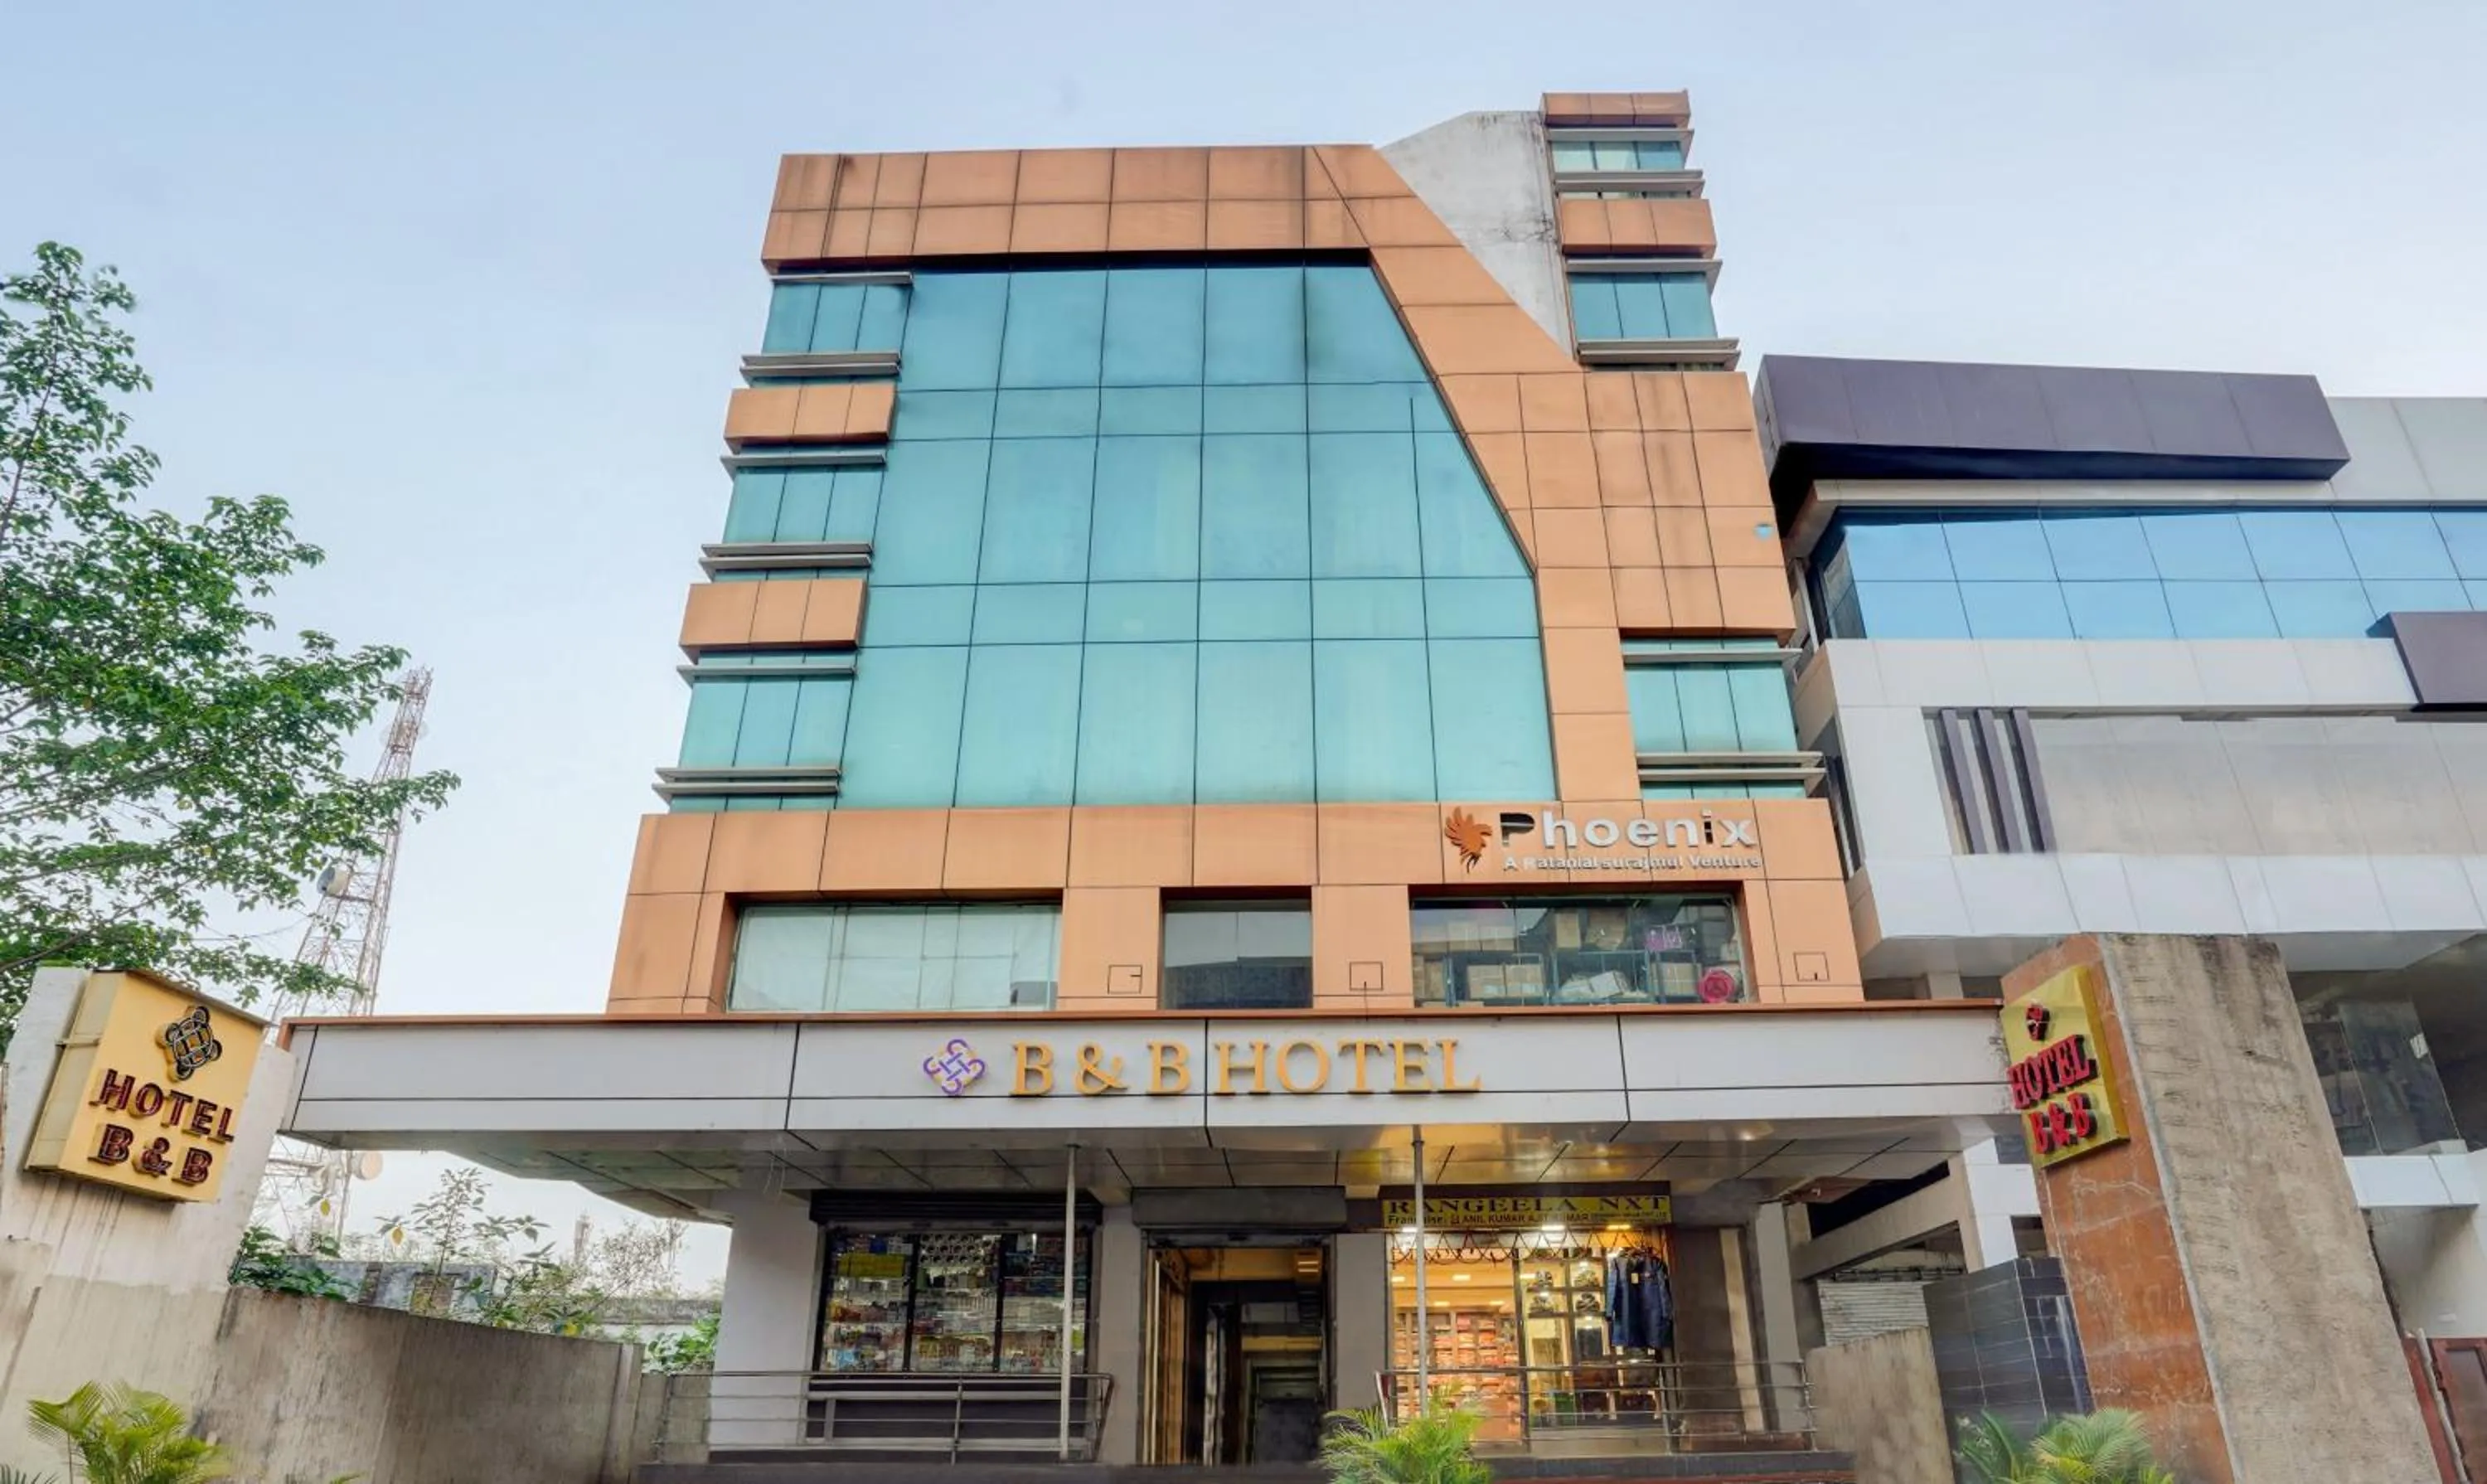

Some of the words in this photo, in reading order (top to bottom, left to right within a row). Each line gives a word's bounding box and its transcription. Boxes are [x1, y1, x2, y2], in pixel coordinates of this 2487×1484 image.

[1500, 809, 1758, 848] Phoenix
[1688, 854, 1762, 869] Venture
[1214, 1039, 1481, 1096] HOTEL
[2006, 1035, 2096, 1110] HOTEL
[95, 1068, 235, 1143] HOTEL
[1599, 1196, 1667, 1210] NXT
